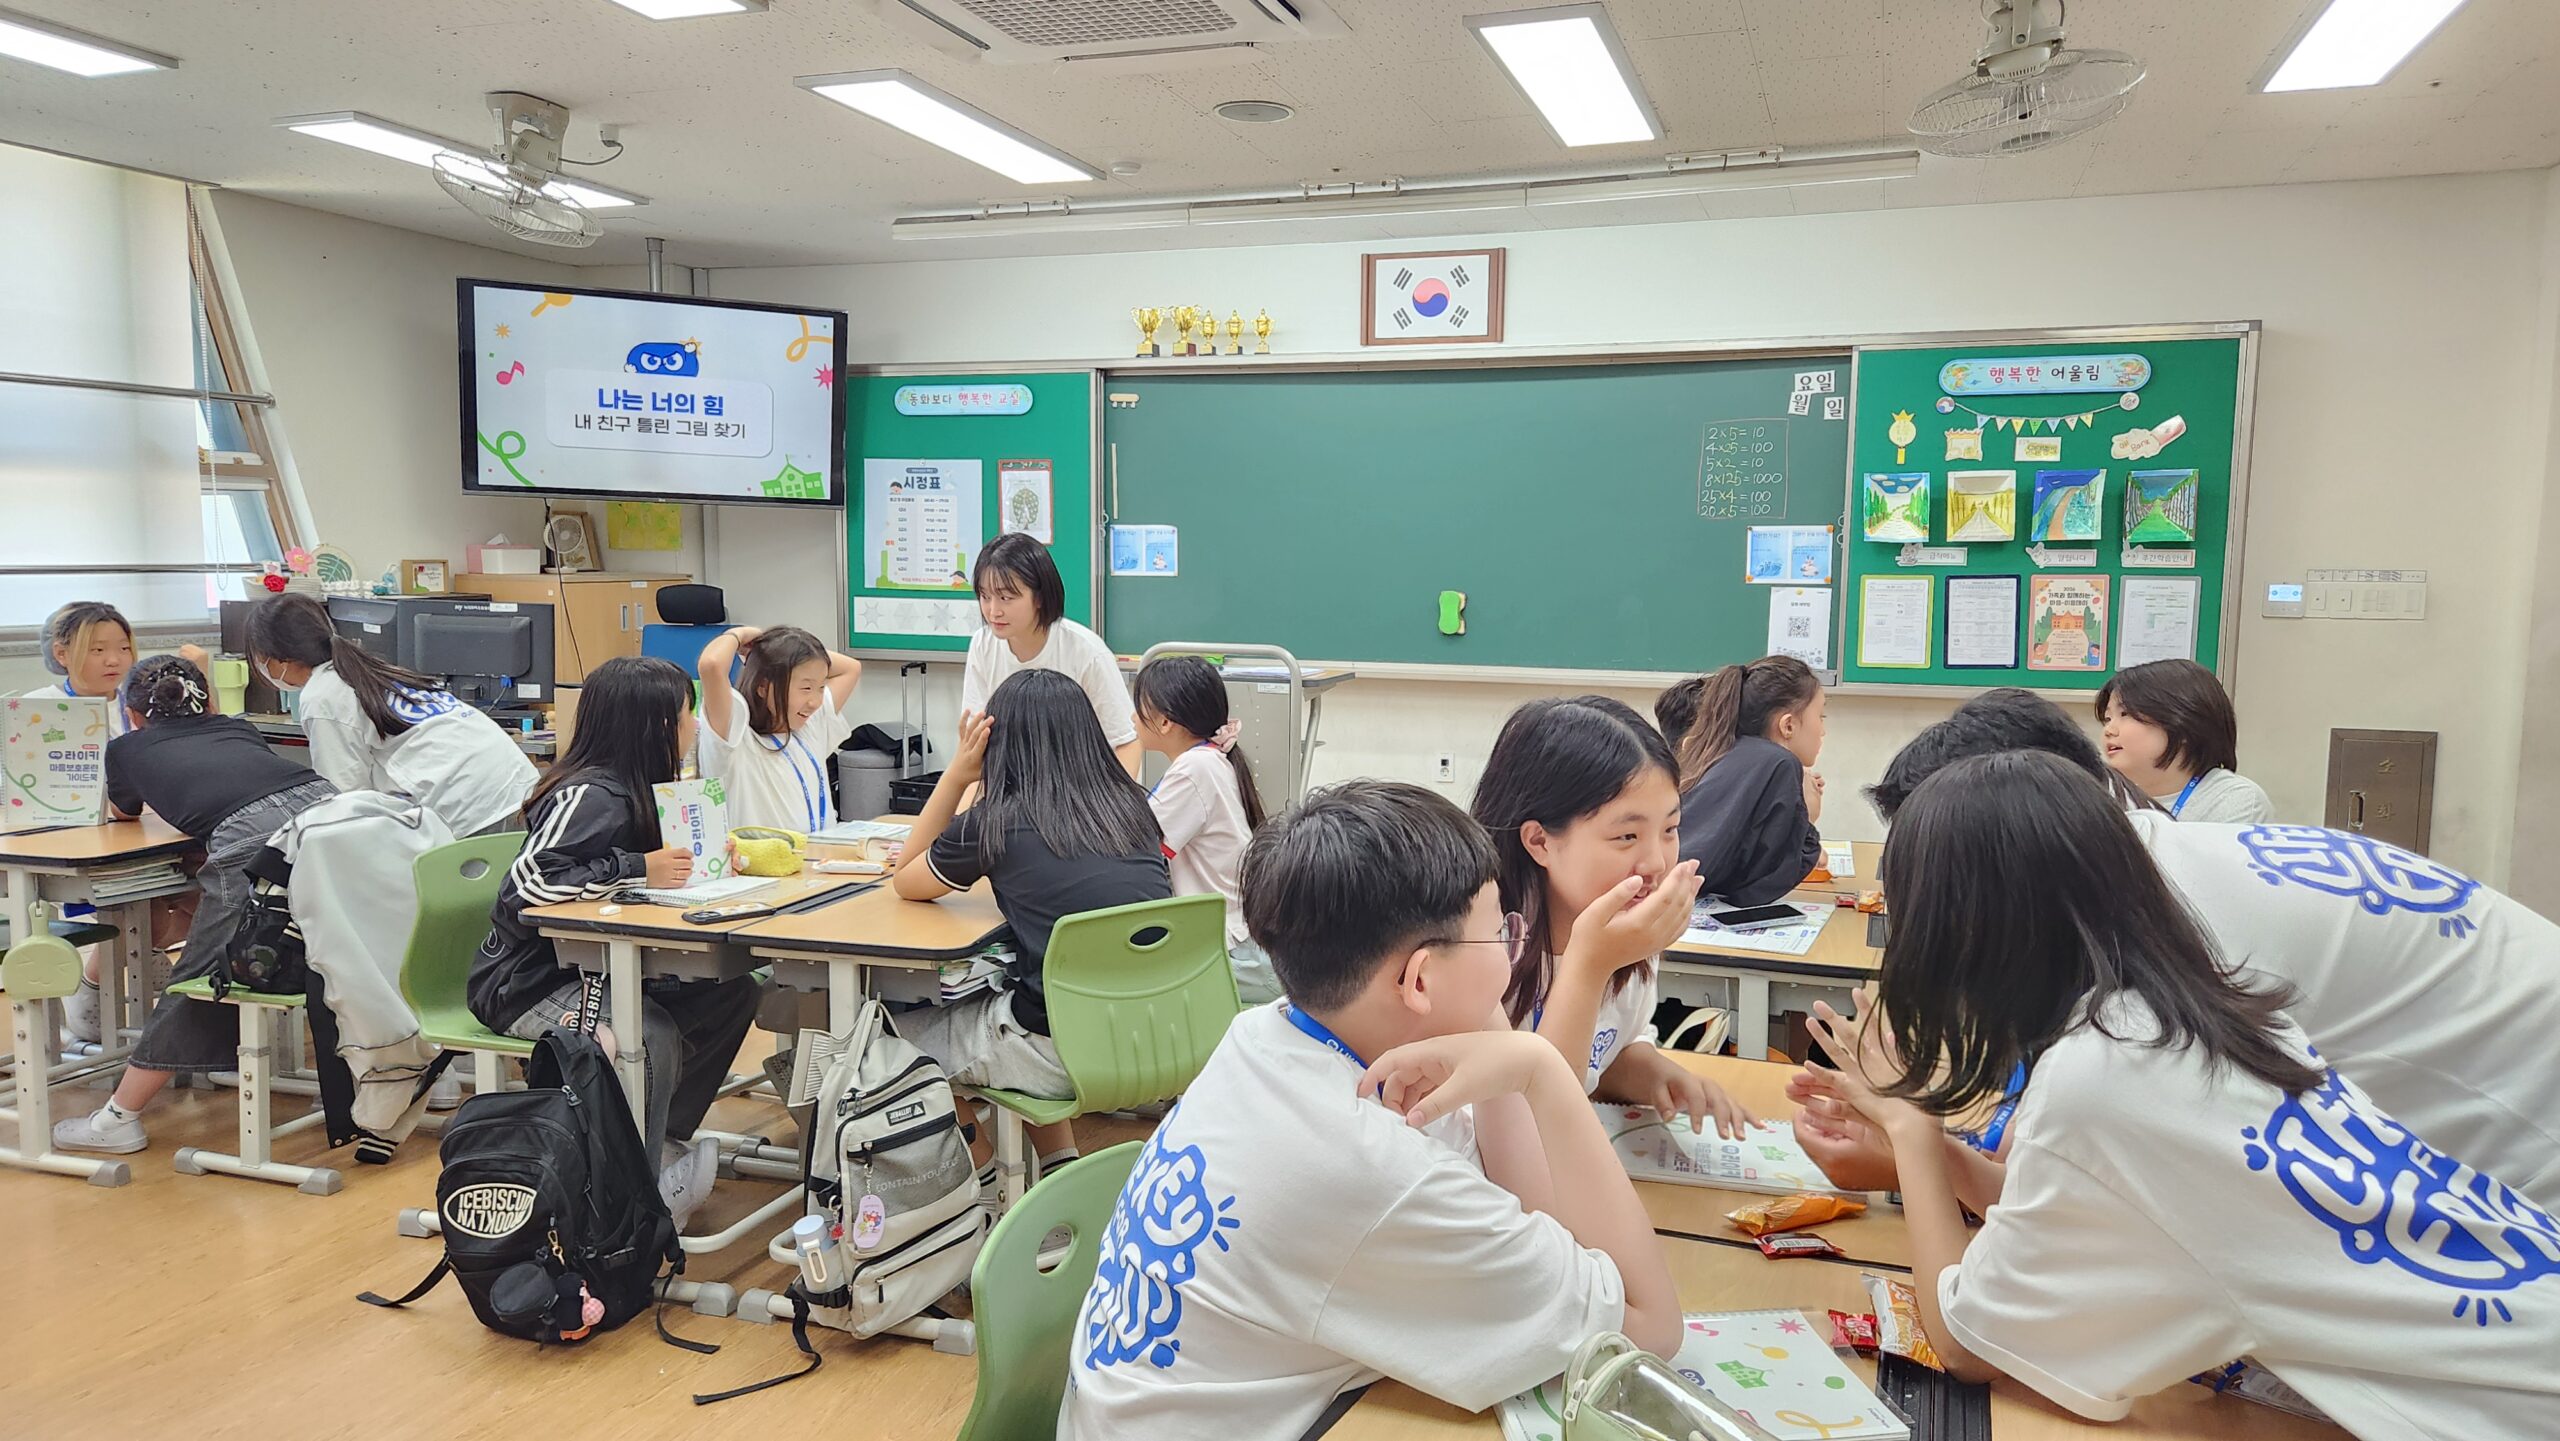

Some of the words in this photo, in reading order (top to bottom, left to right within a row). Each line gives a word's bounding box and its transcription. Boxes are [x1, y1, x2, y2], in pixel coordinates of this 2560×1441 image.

[1798, 373, 1832, 391] 요일
[1989, 365, 2041, 383] 행복한
[2050, 364, 2100, 382] 어울림
[598, 388, 644, 411] 나는
[652, 392, 695, 414] 너의
[703, 395, 724, 416] 힘
[909, 393, 952, 406] 동화보다
[958, 392, 992, 406] 행복한
[999, 391, 1020, 405] 교실
[1792, 394, 1808, 413] 월
[1827, 399, 1842, 417] 일
[575, 414, 591, 430] 내
[597, 416, 631, 432] 친구
[637, 417, 670, 434] 틀린
[676, 420, 708, 437] 그림
[714, 422, 746, 439] 찾기
[904, 476, 941, 490] 시정표
[64, 750, 99, 761] 라이키
[66, 773, 98, 782] 가이드북
[688, 803, 702, 840] 라이키
[876, 1176, 920, 1193] CONTAIN
